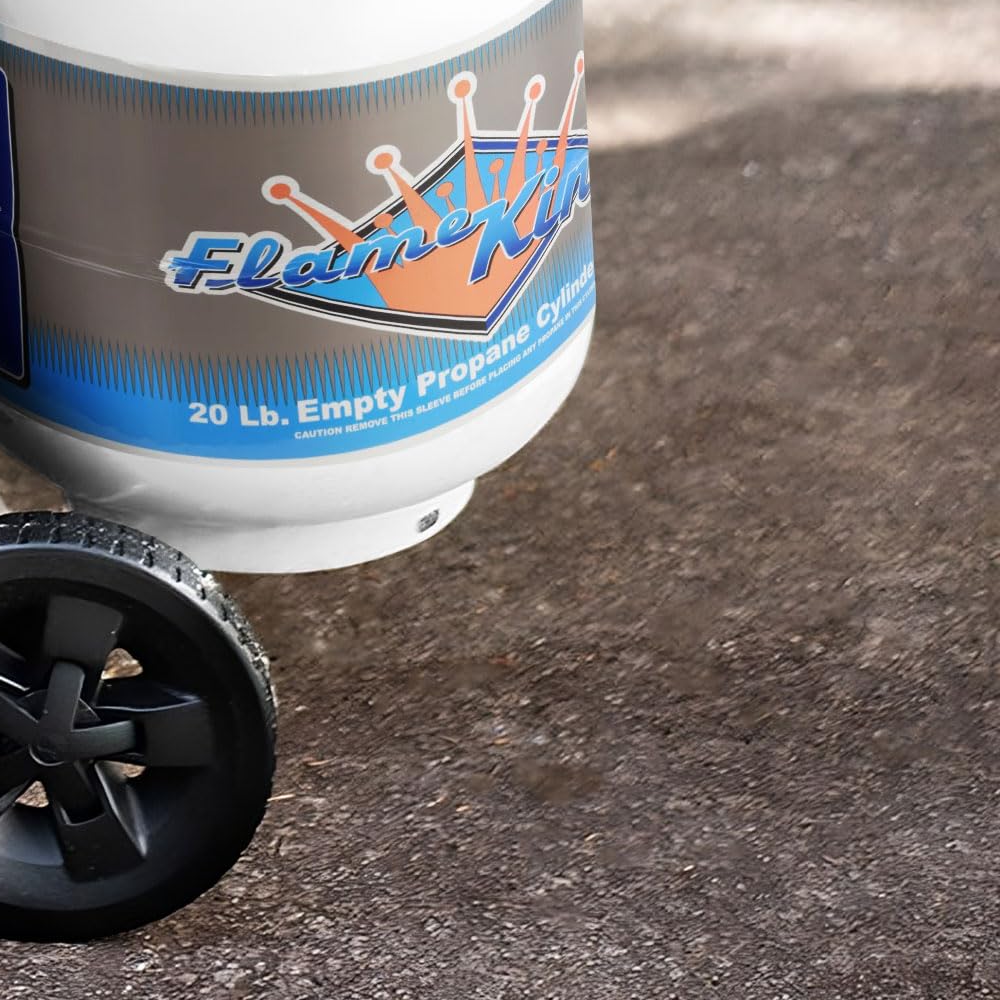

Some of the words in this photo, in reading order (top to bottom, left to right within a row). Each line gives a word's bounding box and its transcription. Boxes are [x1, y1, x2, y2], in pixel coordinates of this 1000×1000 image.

[466, 154, 593, 287] Kin
[188, 402, 228, 426] 20
[239, 404, 290, 427] Lb.
[296, 385, 407, 424] Empty
[416, 323, 531, 398] Propane
[536, 261, 594, 328] Cylinde
[294, 426, 343, 440] CAUTION
[345, 416, 388, 433] REMOVE
[391, 408, 414, 422] THIS
[415, 394, 451, 415] SLEEVE
[453, 375, 488, 399] BEFORE
[488, 353, 522, 382] PLACING
[522, 341, 537, 360] ANY
[537, 317, 565, 347] PROPANE
